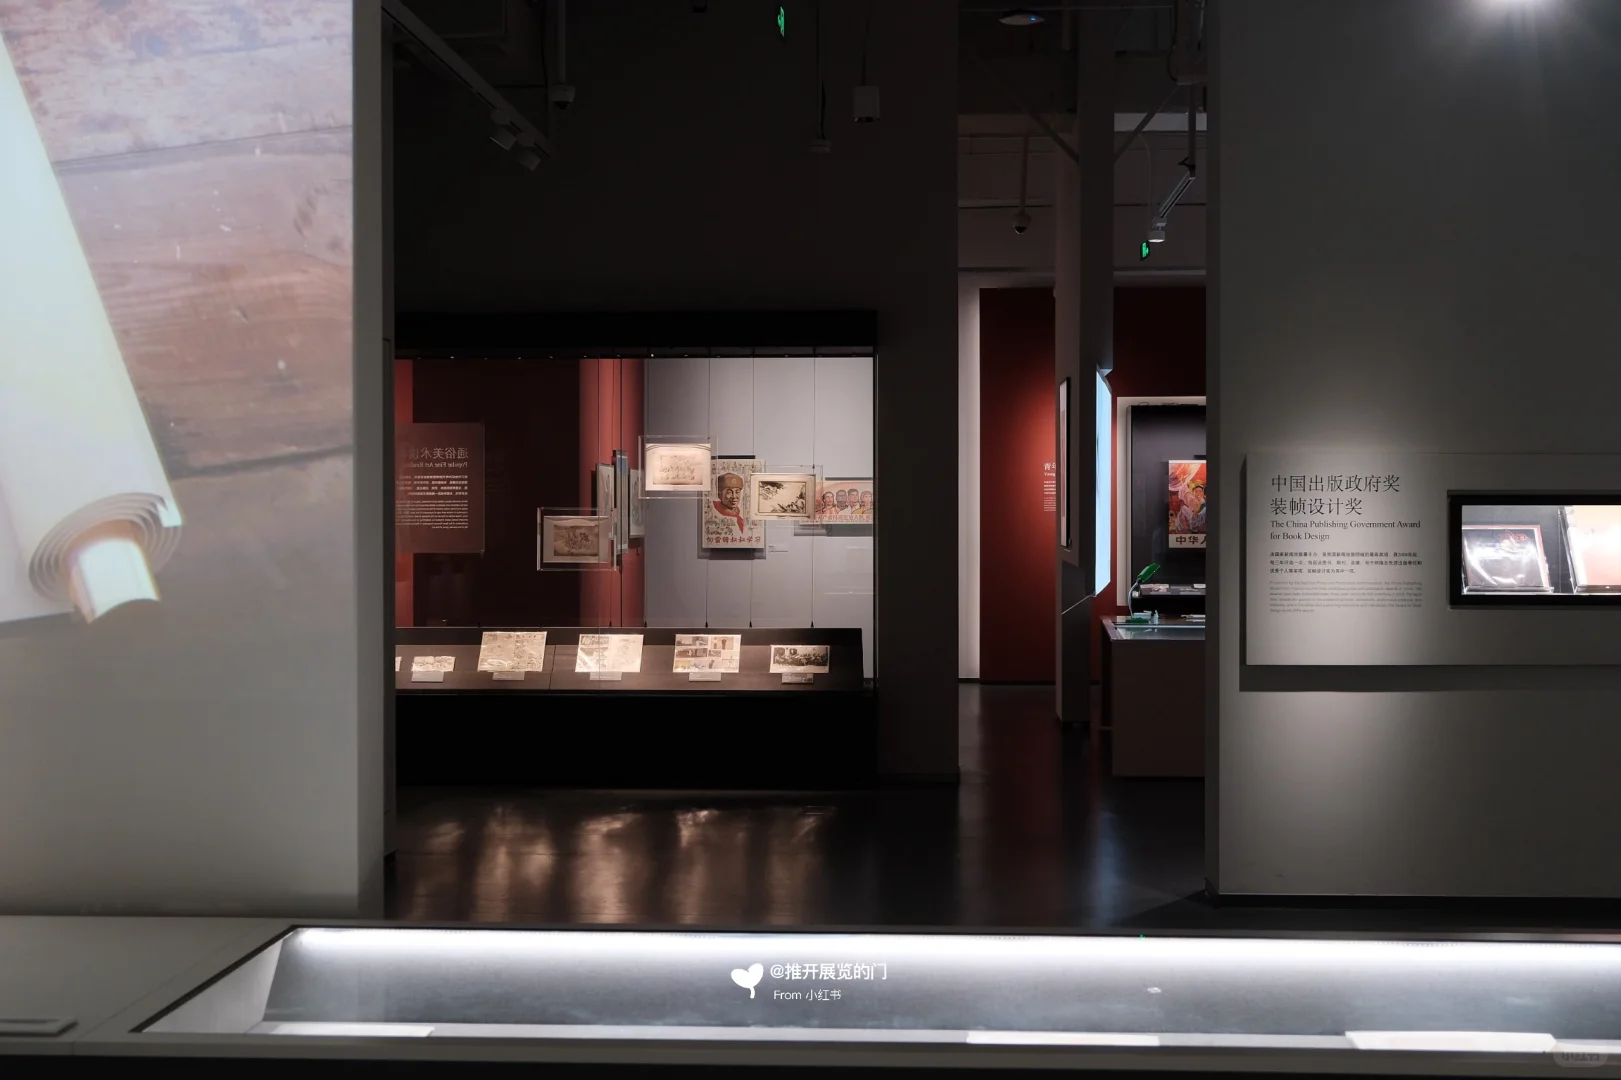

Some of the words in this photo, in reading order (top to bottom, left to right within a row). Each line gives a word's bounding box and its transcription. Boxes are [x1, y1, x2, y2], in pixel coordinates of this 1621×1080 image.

[1271, 474, 1400, 493] 中国出版政府奖
[1270, 498, 1363, 516] 装帧设计奖
[1270, 520, 1284, 528] The
[1286, 520, 1308, 528] China
[1310, 520, 1348, 530] Publishing
[1350, 520, 1395, 528] Government
[1397, 520, 1421, 528] Award
[1270, 532, 1281, 540] for
[1282, 532, 1302, 540] Book
[1304, 532, 1330, 542] Design
